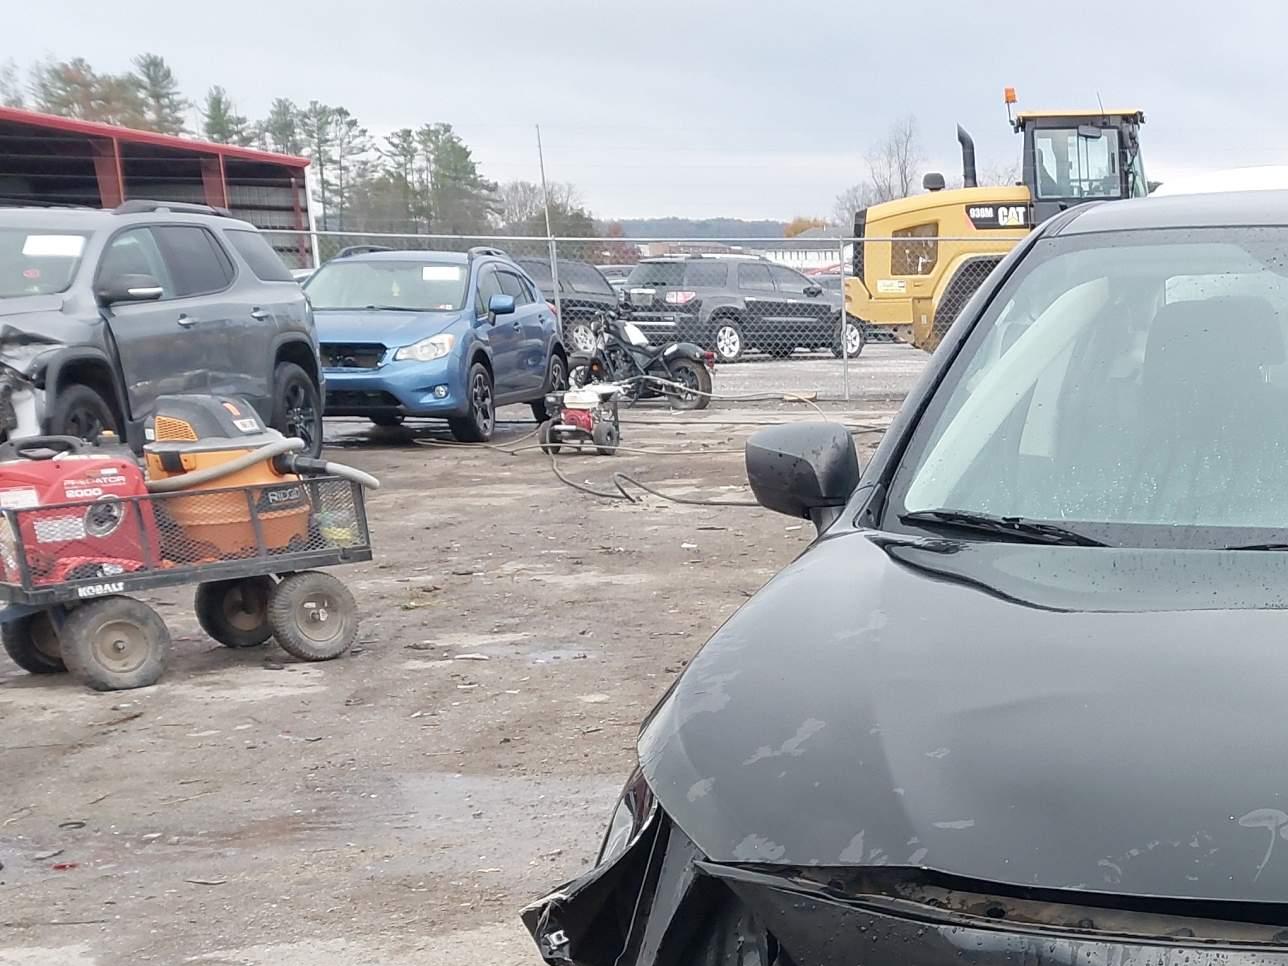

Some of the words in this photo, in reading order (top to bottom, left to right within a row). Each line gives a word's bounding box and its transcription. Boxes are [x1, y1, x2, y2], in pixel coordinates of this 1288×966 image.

[998, 206, 1026, 226] CAT
[268, 487, 300, 503] RIDGID
[78, 582, 124, 597] KOBALT
